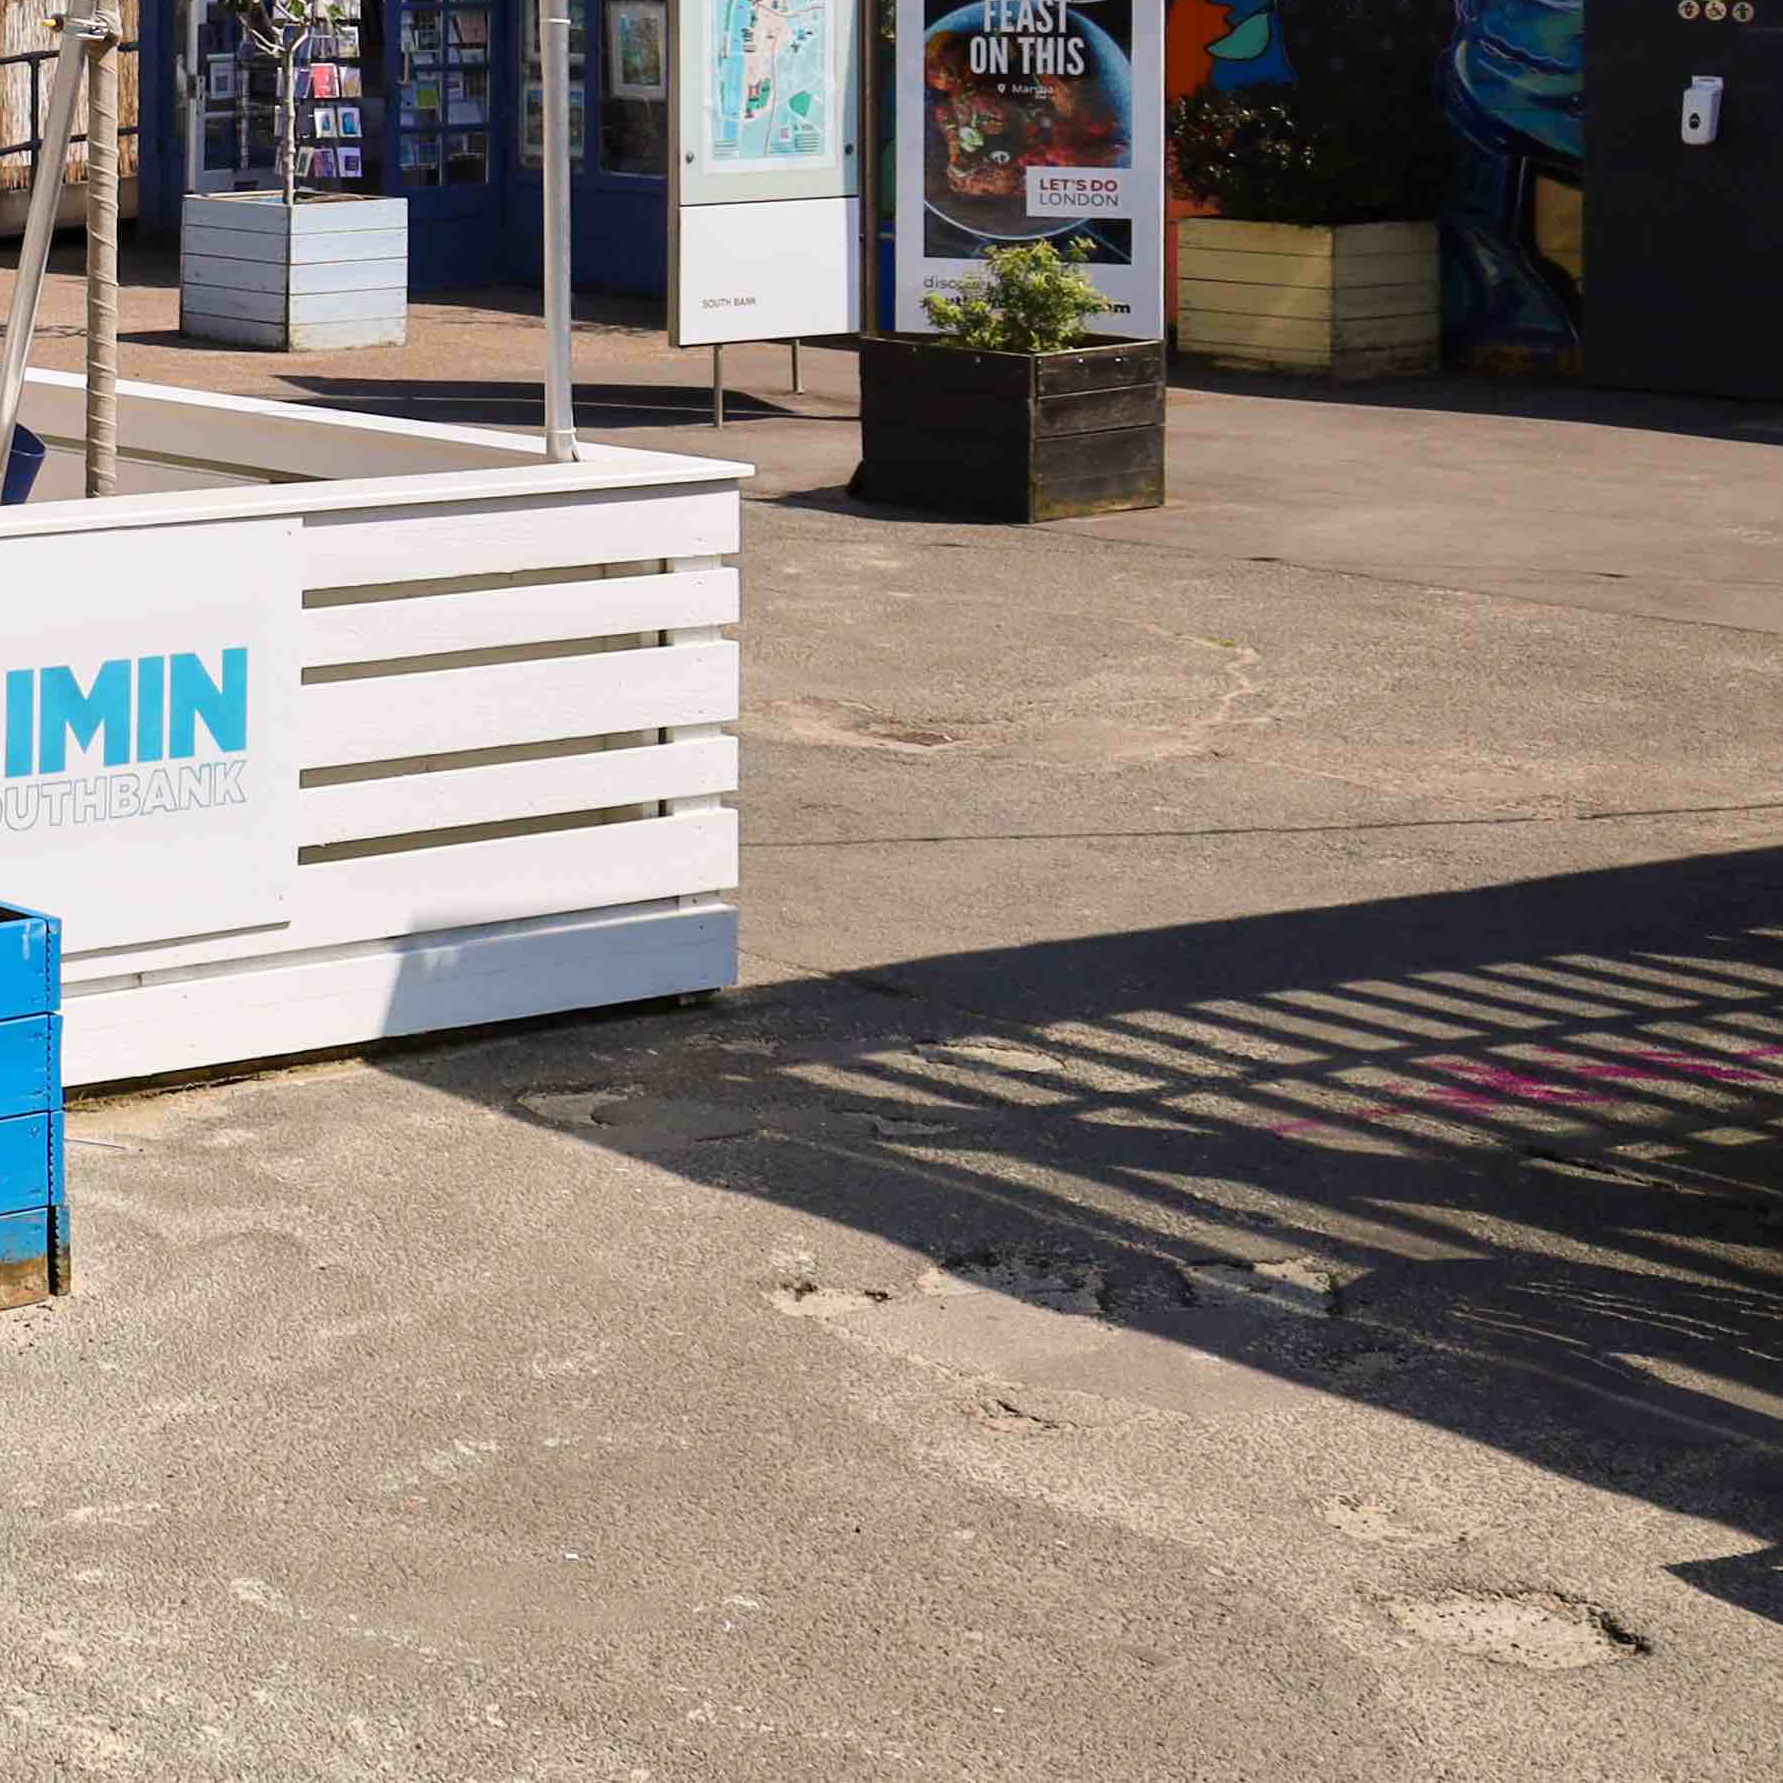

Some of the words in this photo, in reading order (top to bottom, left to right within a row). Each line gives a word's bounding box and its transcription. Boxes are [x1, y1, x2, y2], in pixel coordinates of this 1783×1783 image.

[970, 35, 1009, 75] ON
[1017, 36, 1086, 76] THIS
[1040, 178, 1087, 192] LET'S
[1091, 179, 1118, 192] DO
[1039, 193, 1119, 207] LONDON
